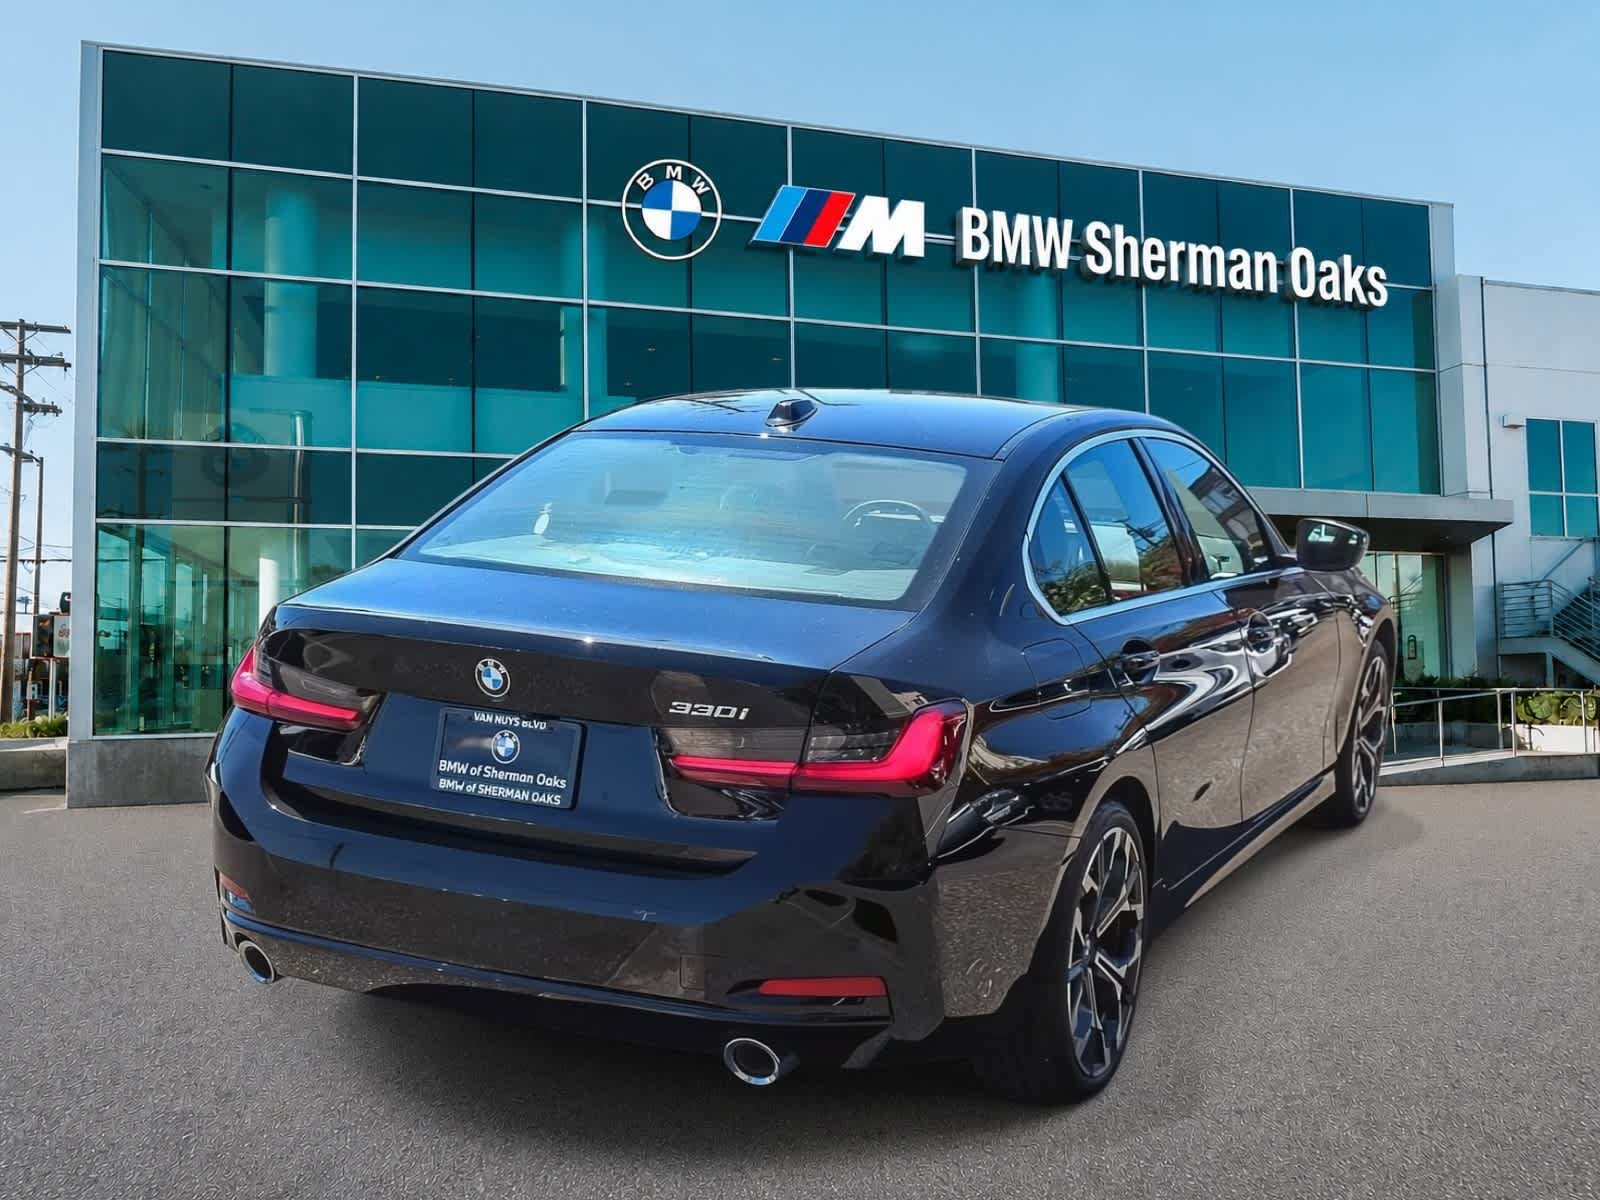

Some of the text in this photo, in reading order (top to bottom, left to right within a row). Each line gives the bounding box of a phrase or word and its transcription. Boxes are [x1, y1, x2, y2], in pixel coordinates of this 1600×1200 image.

[636, 164, 711, 193] BMW
[835, 195, 925, 257] M
[960, 206, 1389, 308] BMW Sherman Oaks
[474, 711, 547, 730] VAN NUYS BLVD
[669, 701, 750, 720] 330i
[439, 760, 567, 789] BMW of Sherman Oaks
[438, 778, 561, 805] BMW of SHERMAN OAKS
